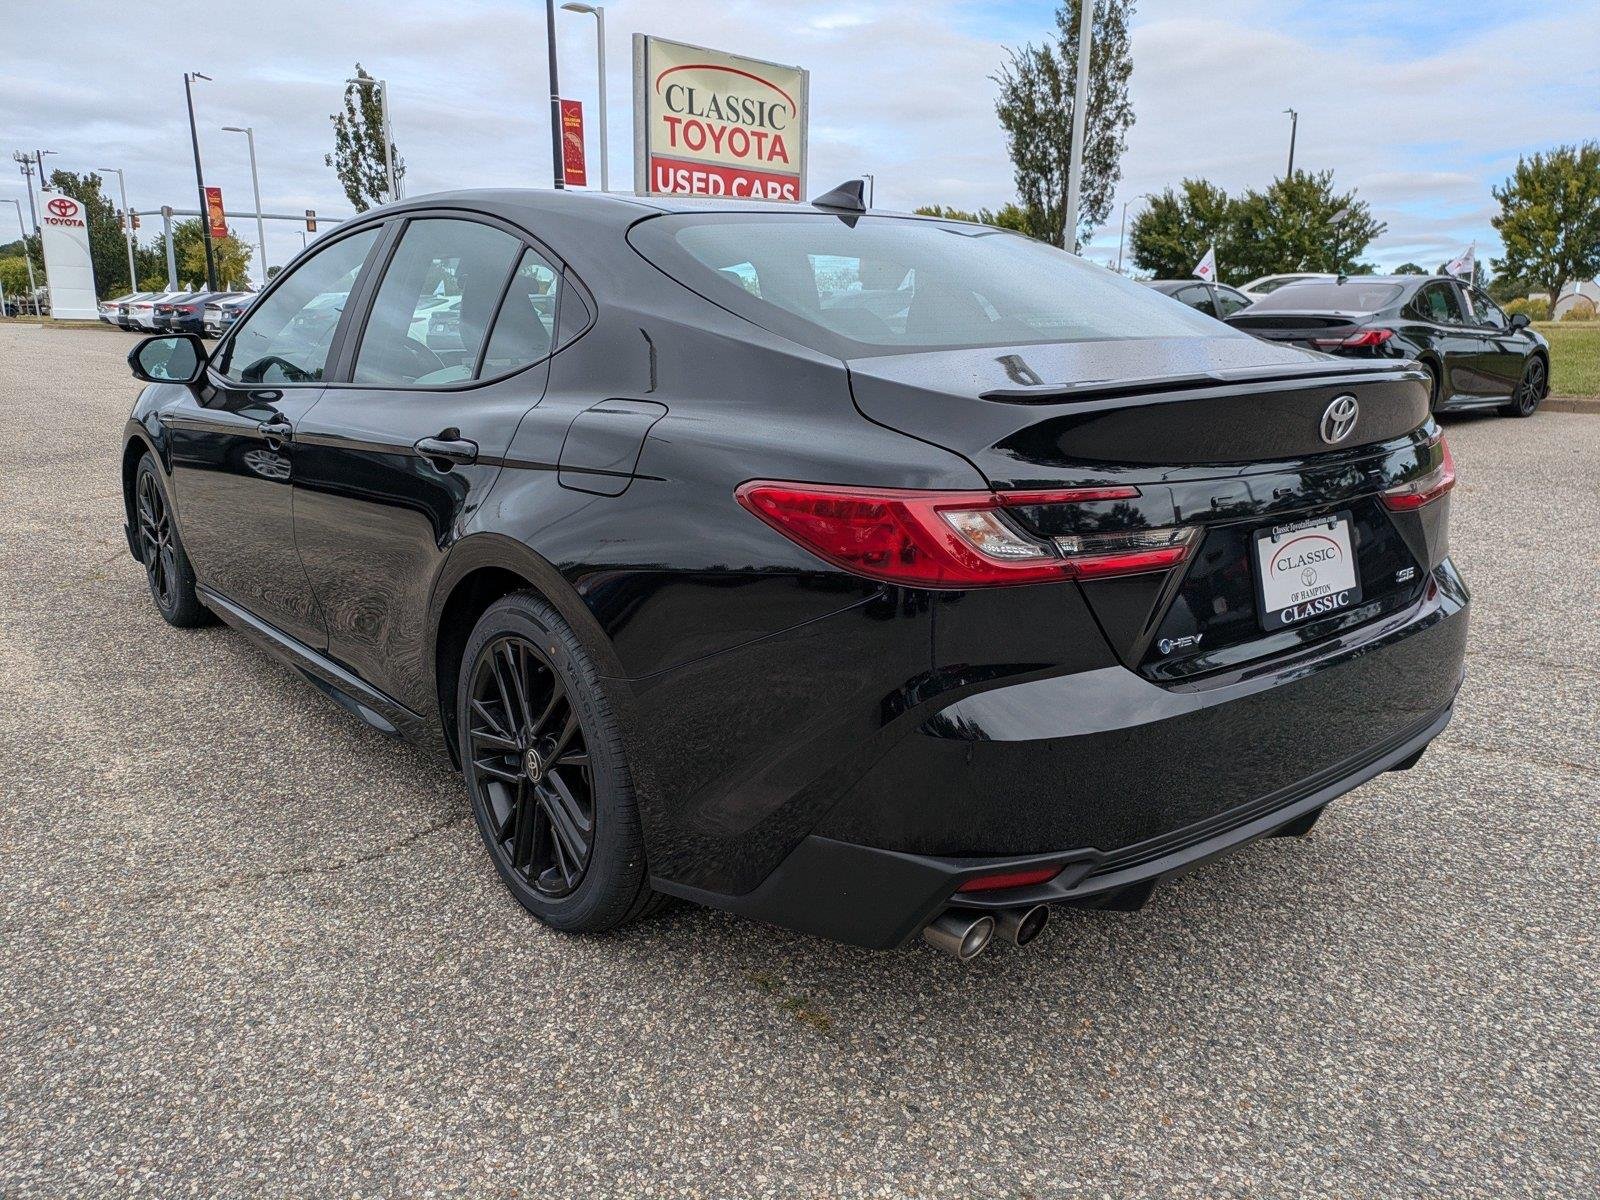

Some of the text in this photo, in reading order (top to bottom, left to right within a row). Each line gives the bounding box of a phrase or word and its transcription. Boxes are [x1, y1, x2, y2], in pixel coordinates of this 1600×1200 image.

[665, 83, 787, 130] CLASSIC
[663, 115, 789, 164] TOYOTA
[656, 166, 795, 201] USED CARS
[43, 216, 85, 227] TOYOTA
[1277, 547, 1336, 572] CLASSIC
[1280, 591, 1349, 624] CLASSIC
[1291, 584, 1332, 603] OF HAMPTON
